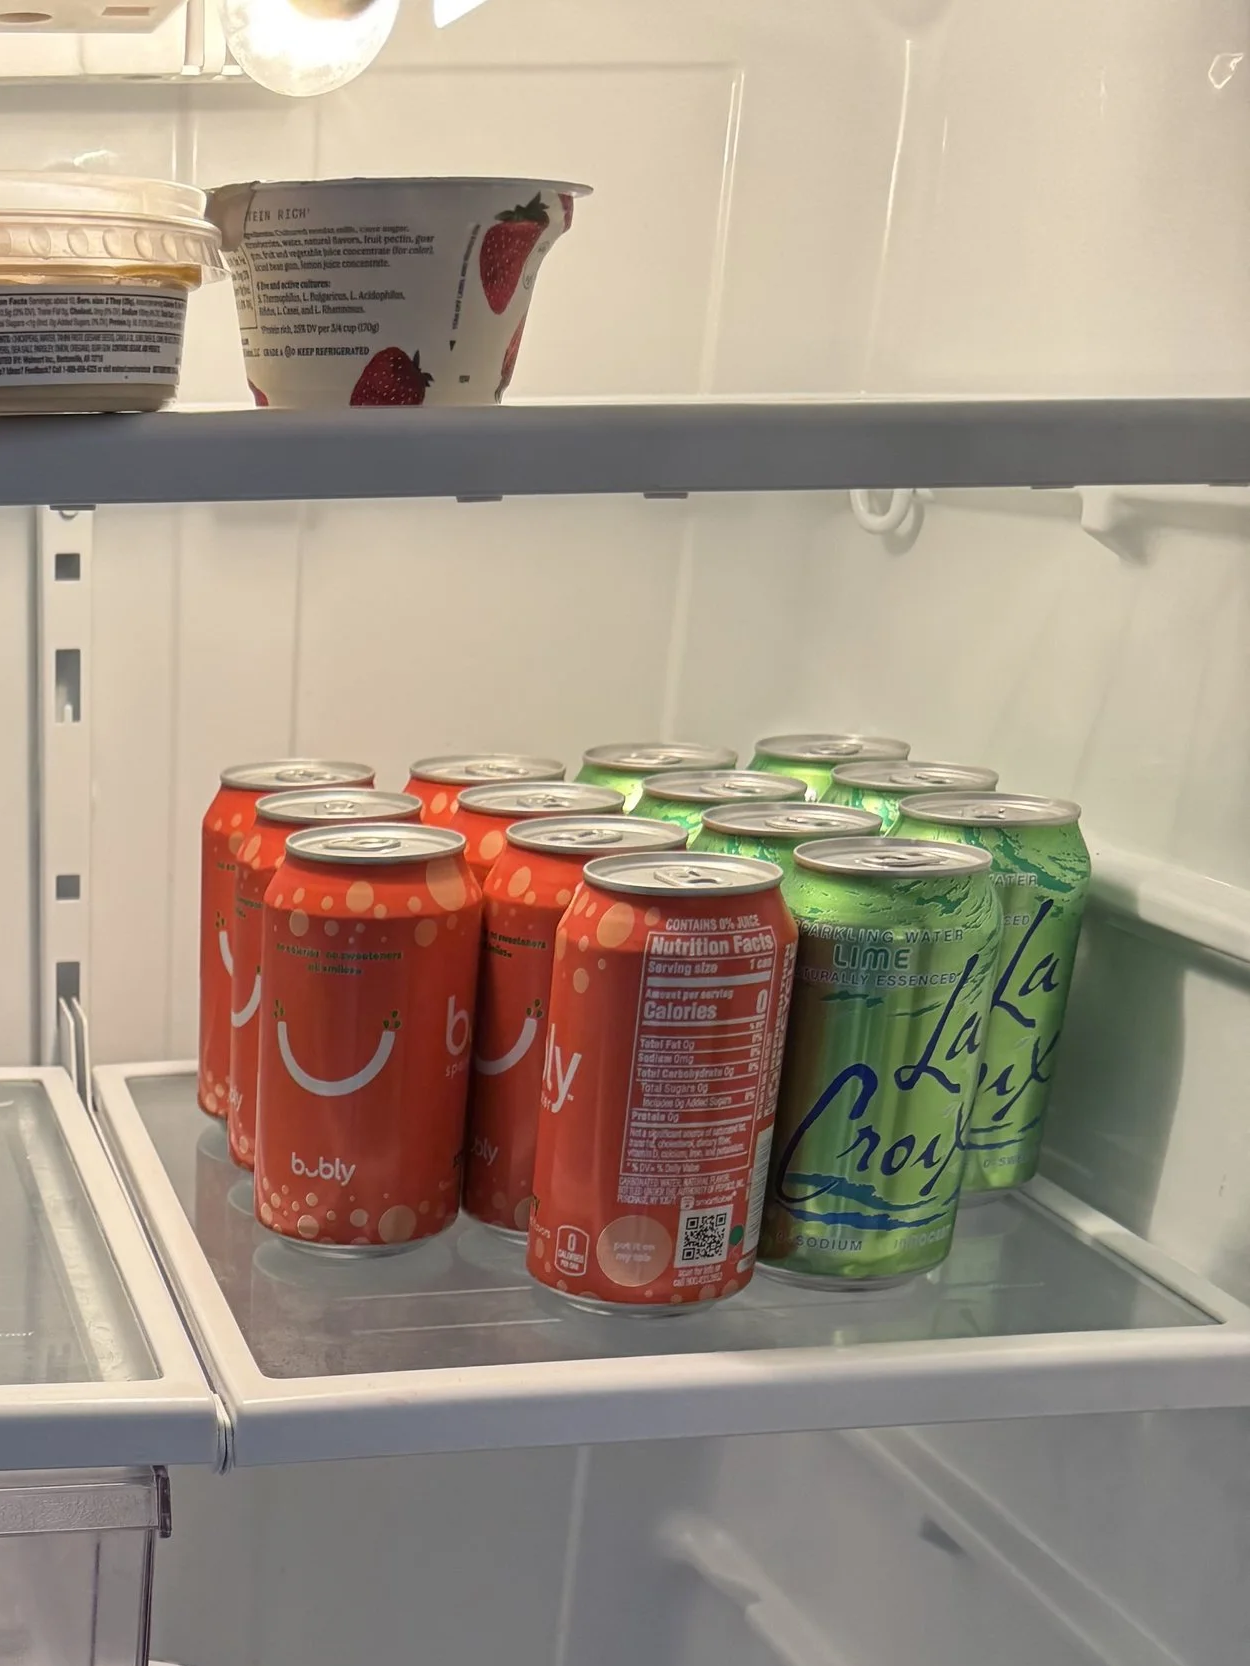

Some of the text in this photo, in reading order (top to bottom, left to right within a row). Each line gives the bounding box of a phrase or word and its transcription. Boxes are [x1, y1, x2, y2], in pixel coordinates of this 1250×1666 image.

[317, 323, 330, 335] per
[342, 323, 357, 335] cup
[357, 321, 380, 335] (170g)
[314, 345, 370, 357] REFRIGERATED
[989, 871, 1038, 887] ATER
[665, 913, 762, 931] CONTAINS 0% JUICE
[650, 932, 775, 957] Nutrition Facts
[905, 928, 964, 945] WATER
[832, 944, 913, 972] LIME
[990, 898, 1060, 1029] La
[647, 960, 693, 976] Serving
[693, 961, 719, 974] size
[876, 971, 959, 988] ESSENCED
[644, 988, 734, 1002] Amount per serving
[643, 988, 769, 1020] Calories 0
[893, 953, 982, 1094] La
[640, 1038, 696, 1051] Total Fat 0g
[637, 1052, 695, 1065] Sodium 0mg
[636, 1066, 736, 1080] Total Carbohydrate 0g
[640, 1082, 709, 1095] Total Sugars 0g
[631, 1110, 681, 1124] Protein 0g
[776, 1062, 974, 1203] Croix
[290, 1150, 357, 1187] bubly
[566, 1232, 578, 1252] 0
